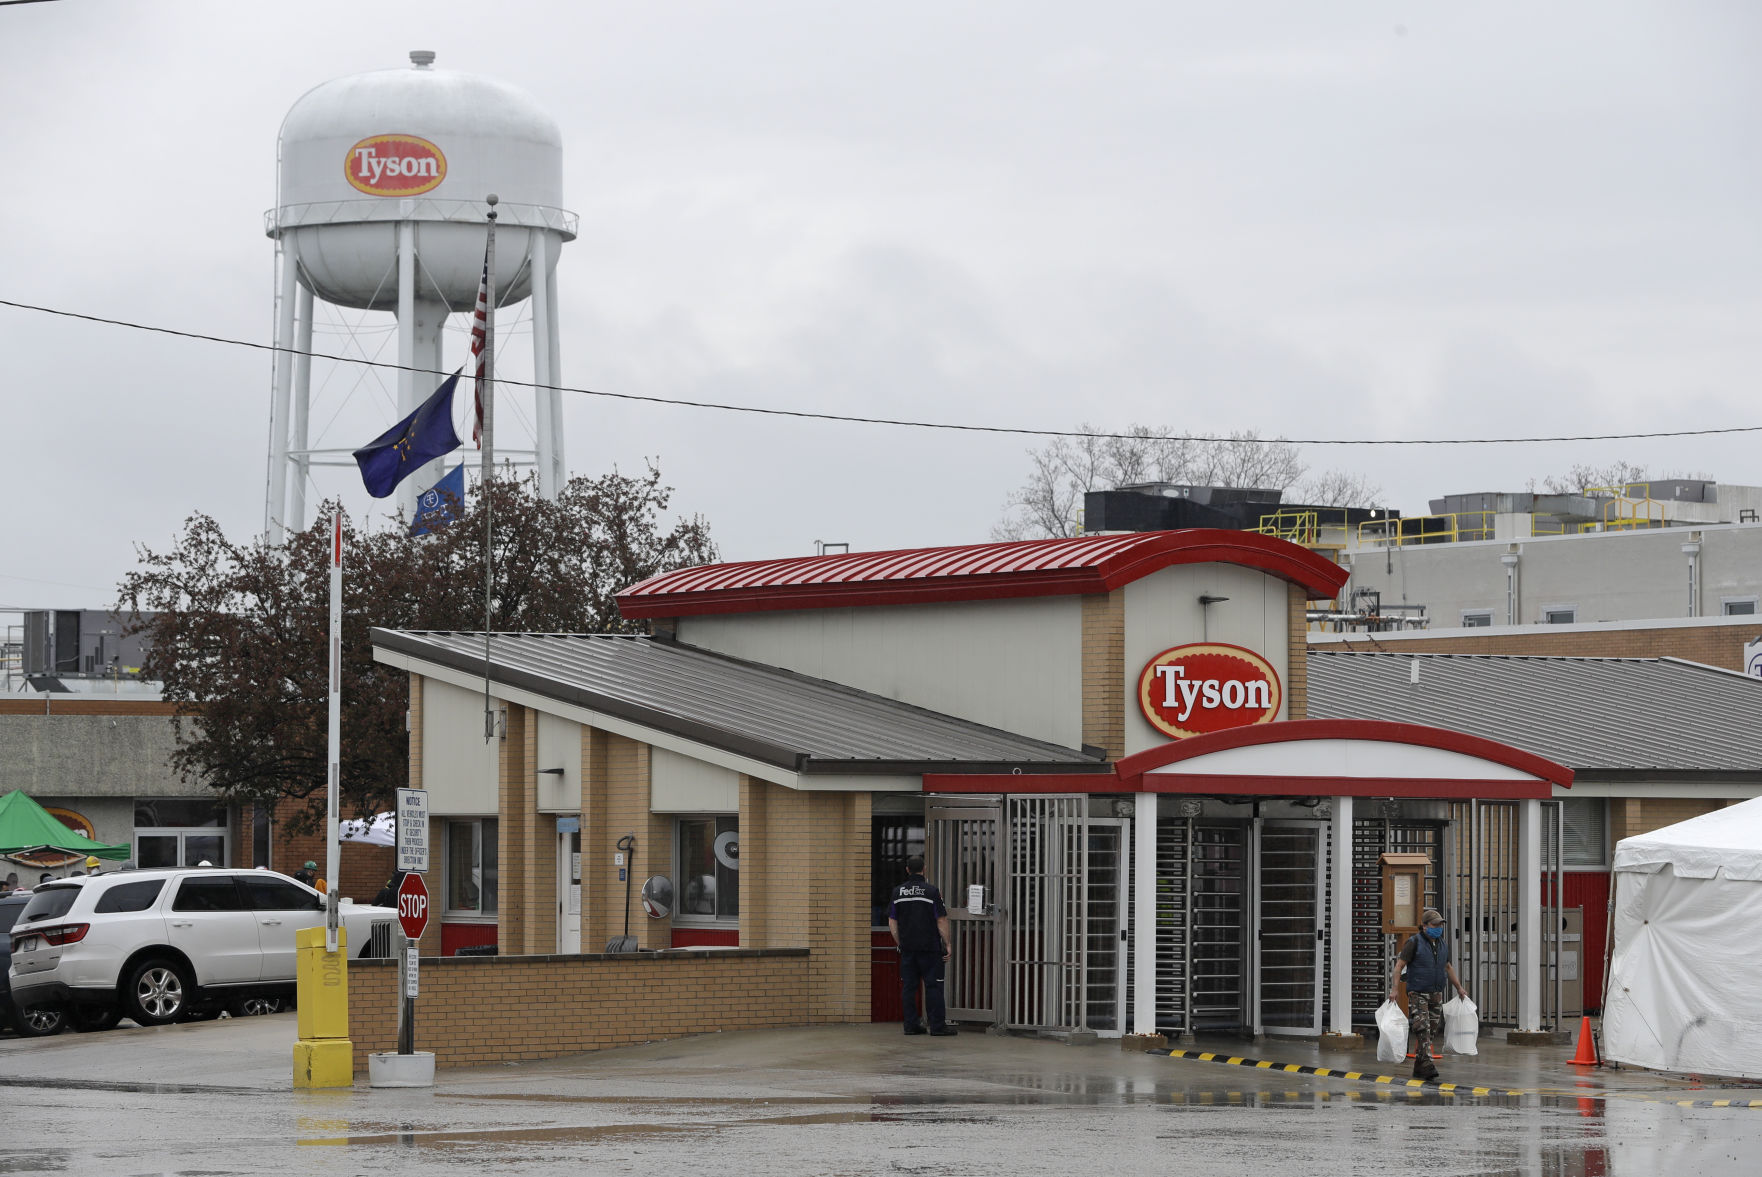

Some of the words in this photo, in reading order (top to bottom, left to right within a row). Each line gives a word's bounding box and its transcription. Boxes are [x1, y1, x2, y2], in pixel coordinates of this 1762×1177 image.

[355, 147, 440, 184] Tyson
[1156, 665, 1272, 722] Tyson
[406, 796, 421, 807] NOTICE
[899, 885, 926, 896] FedEx
[400, 894, 427, 919] STOP
